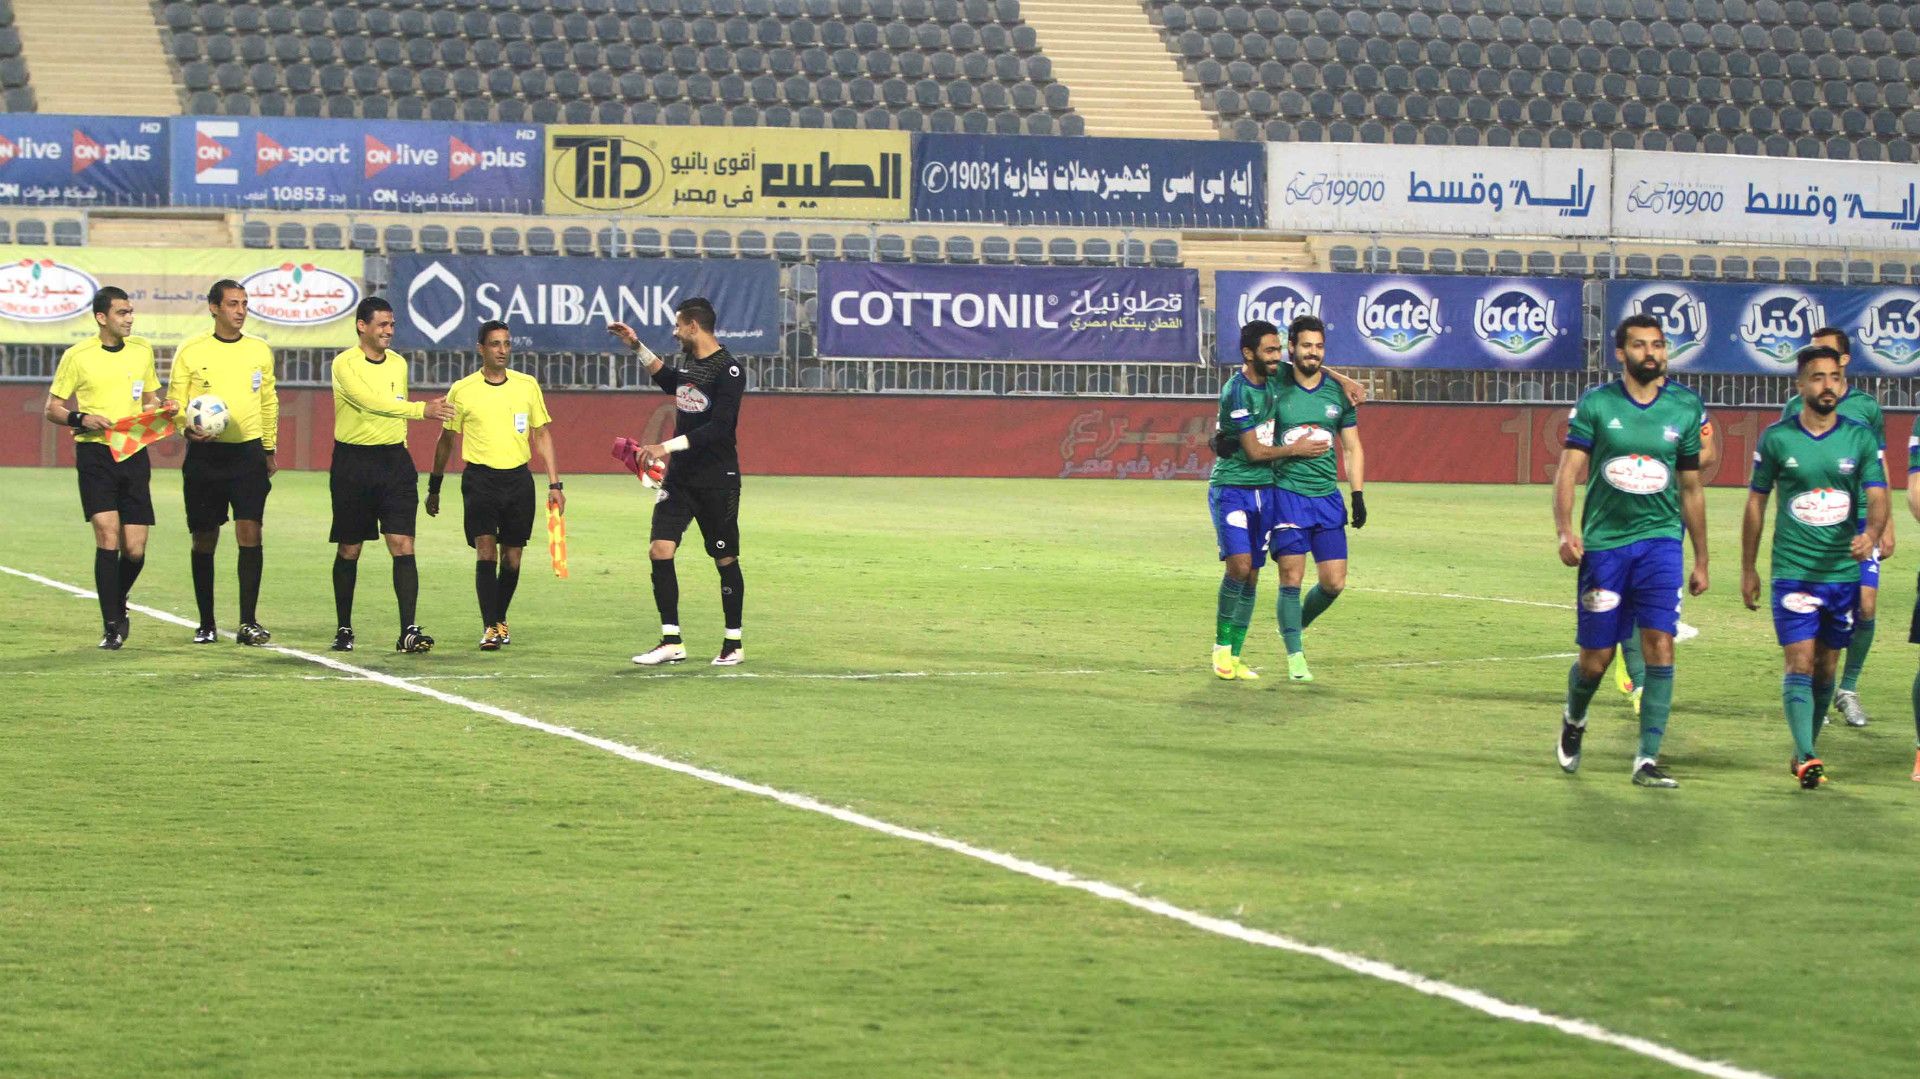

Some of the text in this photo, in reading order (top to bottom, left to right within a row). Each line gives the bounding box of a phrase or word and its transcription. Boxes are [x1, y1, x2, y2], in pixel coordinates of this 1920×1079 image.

[140, 122, 161, 133] HD
[516, 129, 536, 141] HD
[104, 139, 151, 163] plus
[288, 143, 350, 167] sport
[396, 143, 439, 166] live
[480, 146, 527, 170] plus
[761, 152, 901, 208] الطيب
[950, 161, 999, 190] 19031
[272, 186, 327, 201] 10853
[373, 189, 397, 202] ON
[672, 188, 716, 208] مصر
[1327, 180, 1385, 206] 19900
[1667, 189, 1724, 215] 19900
[305, 305, 338, 319] LAND
[475, 282, 680, 327] SAIBANK
[1356, 295, 1444, 338] lactel
[1473, 298, 1559, 340] lactel
